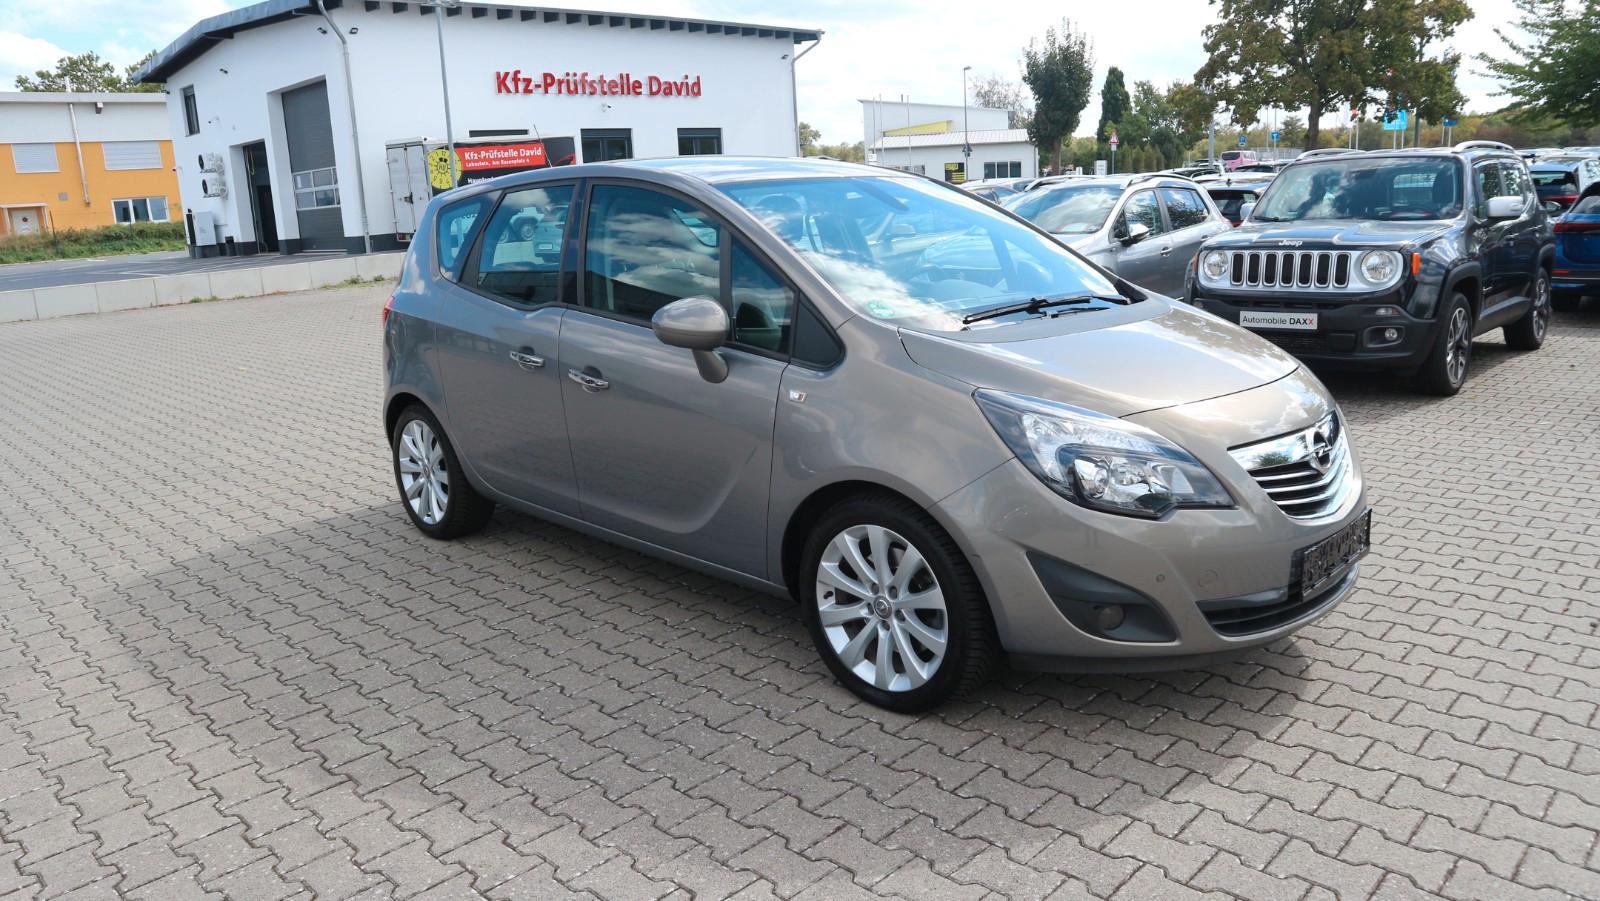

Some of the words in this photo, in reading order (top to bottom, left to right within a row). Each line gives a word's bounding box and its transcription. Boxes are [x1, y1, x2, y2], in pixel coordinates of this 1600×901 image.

[495, 70, 643, 96] Kfz-Prüfstelle
[647, 74, 702, 97] David
[464, 150, 518, 160] Kfz-Prüfstelle
[520, 147, 541, 156] David
[1278, 239, 1303, 247] Jeep
[1242, 315, 1287, 325] Automobile
[1289, 317, 1314, 326] DAXX
